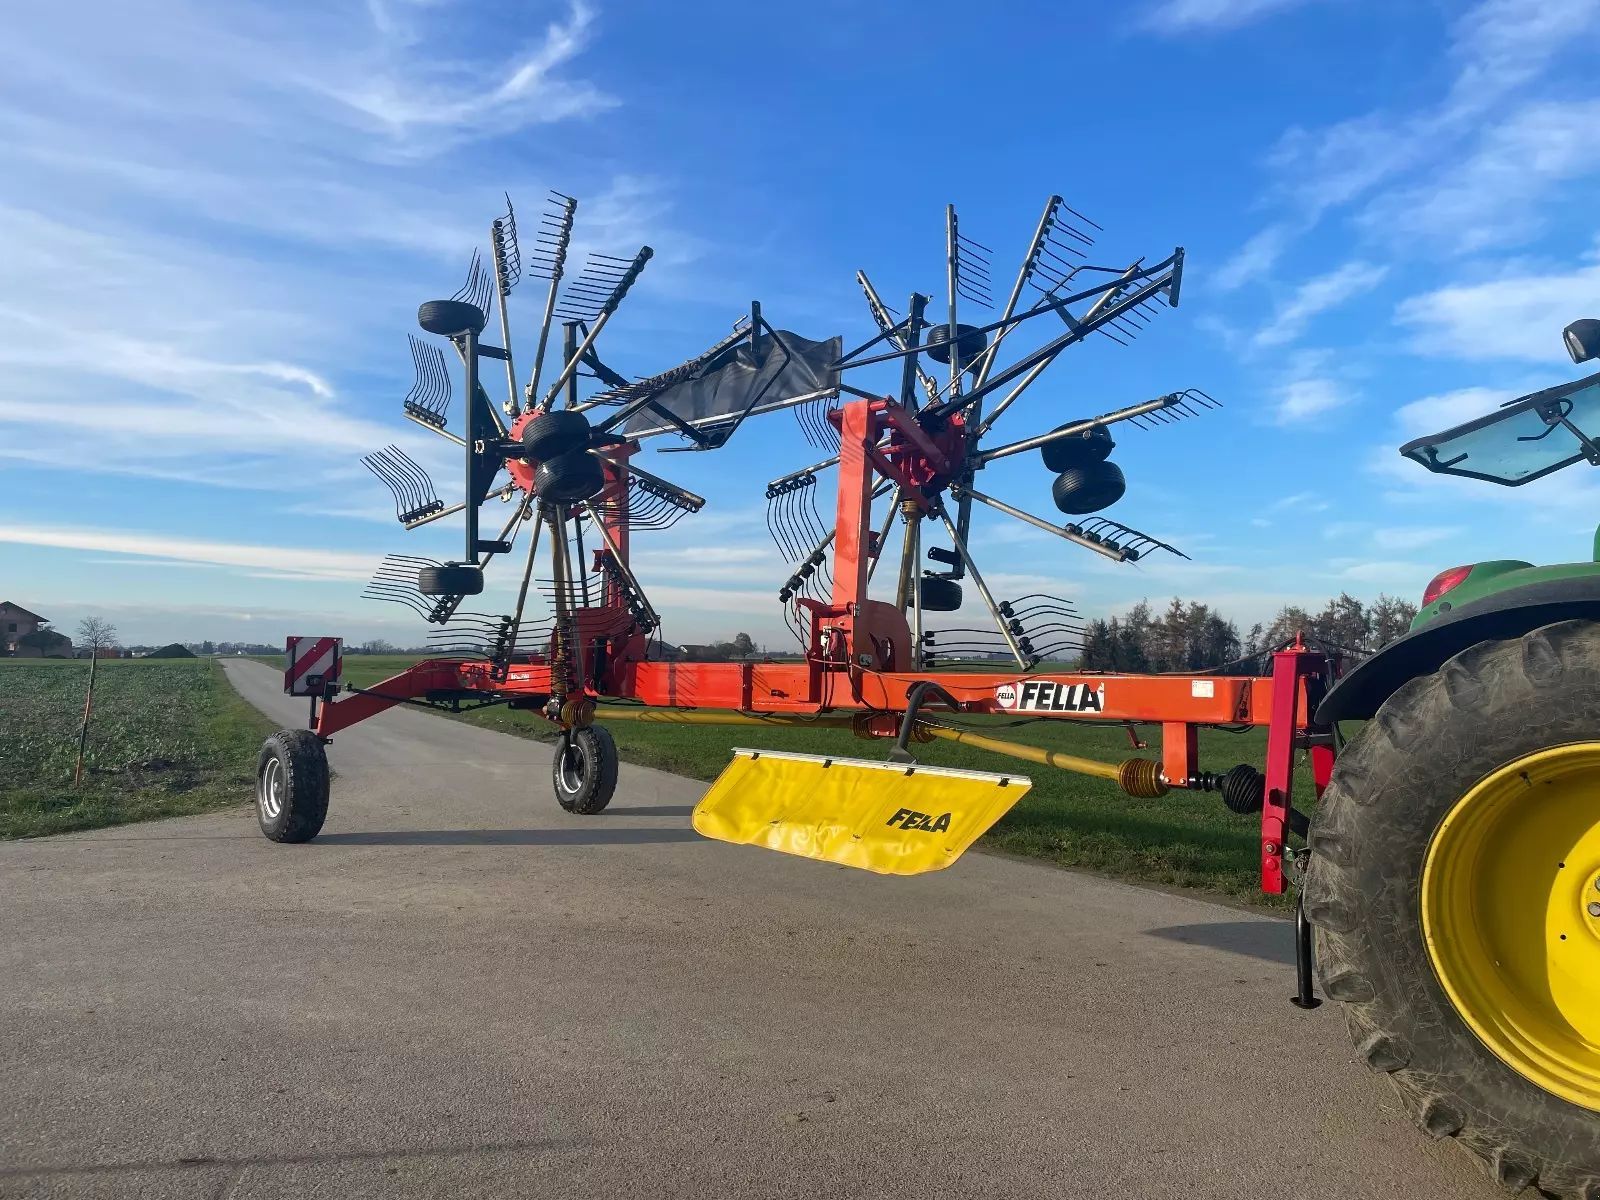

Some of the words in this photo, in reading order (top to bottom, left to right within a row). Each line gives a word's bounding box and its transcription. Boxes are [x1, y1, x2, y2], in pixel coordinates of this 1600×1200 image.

[997, 692, 1015, 700] FELLA
[1019, 683, 1101, 711] FELLA
[886, 808, 951, 832] FELLA
